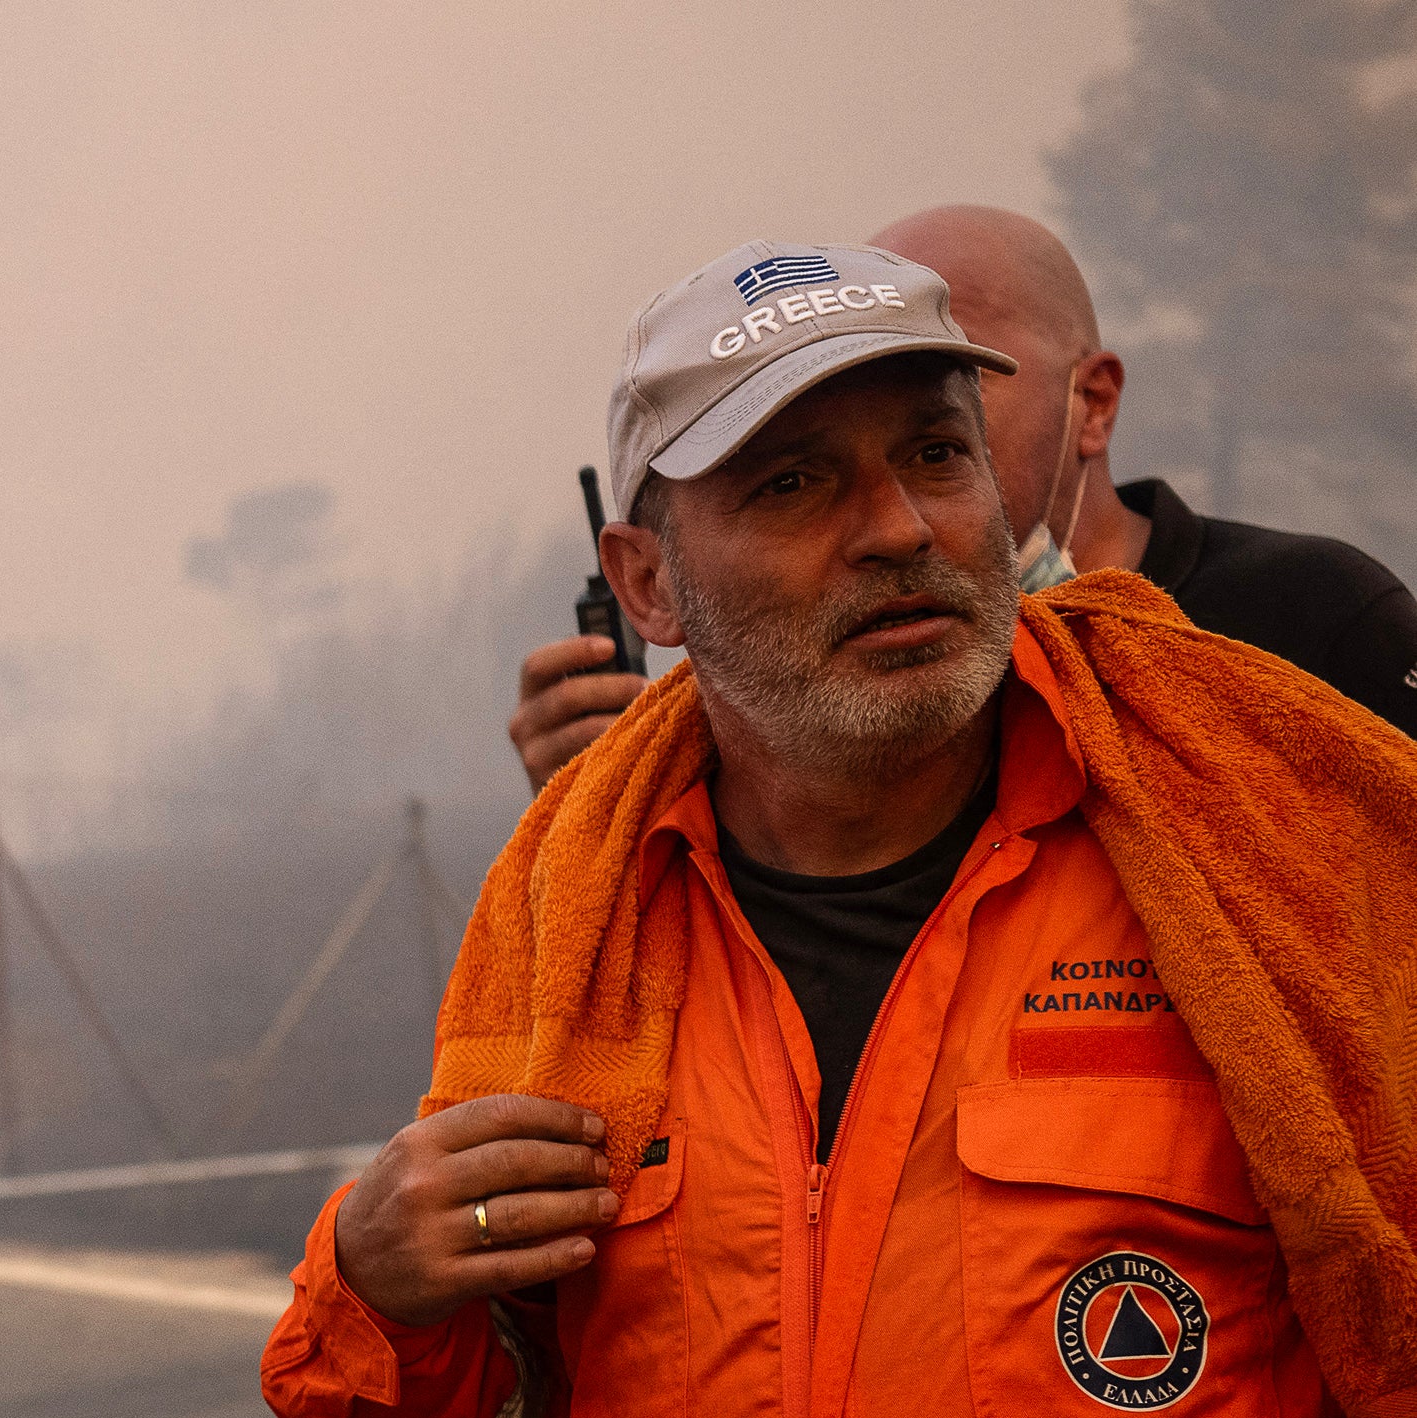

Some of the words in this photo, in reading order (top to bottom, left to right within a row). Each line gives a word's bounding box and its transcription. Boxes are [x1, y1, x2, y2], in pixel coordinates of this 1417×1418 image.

[709, 284, 906, 360] GREECE
[1063, 1262, 1116, 1365] ΠΟΛΙΤΙΚΗ
[1122, 1260, 1203, 1352] ΠΡΟΣΤΑΣΙΑ
[1102, 1381, 1180, 1405] ΕΛΛΑΔΑ
